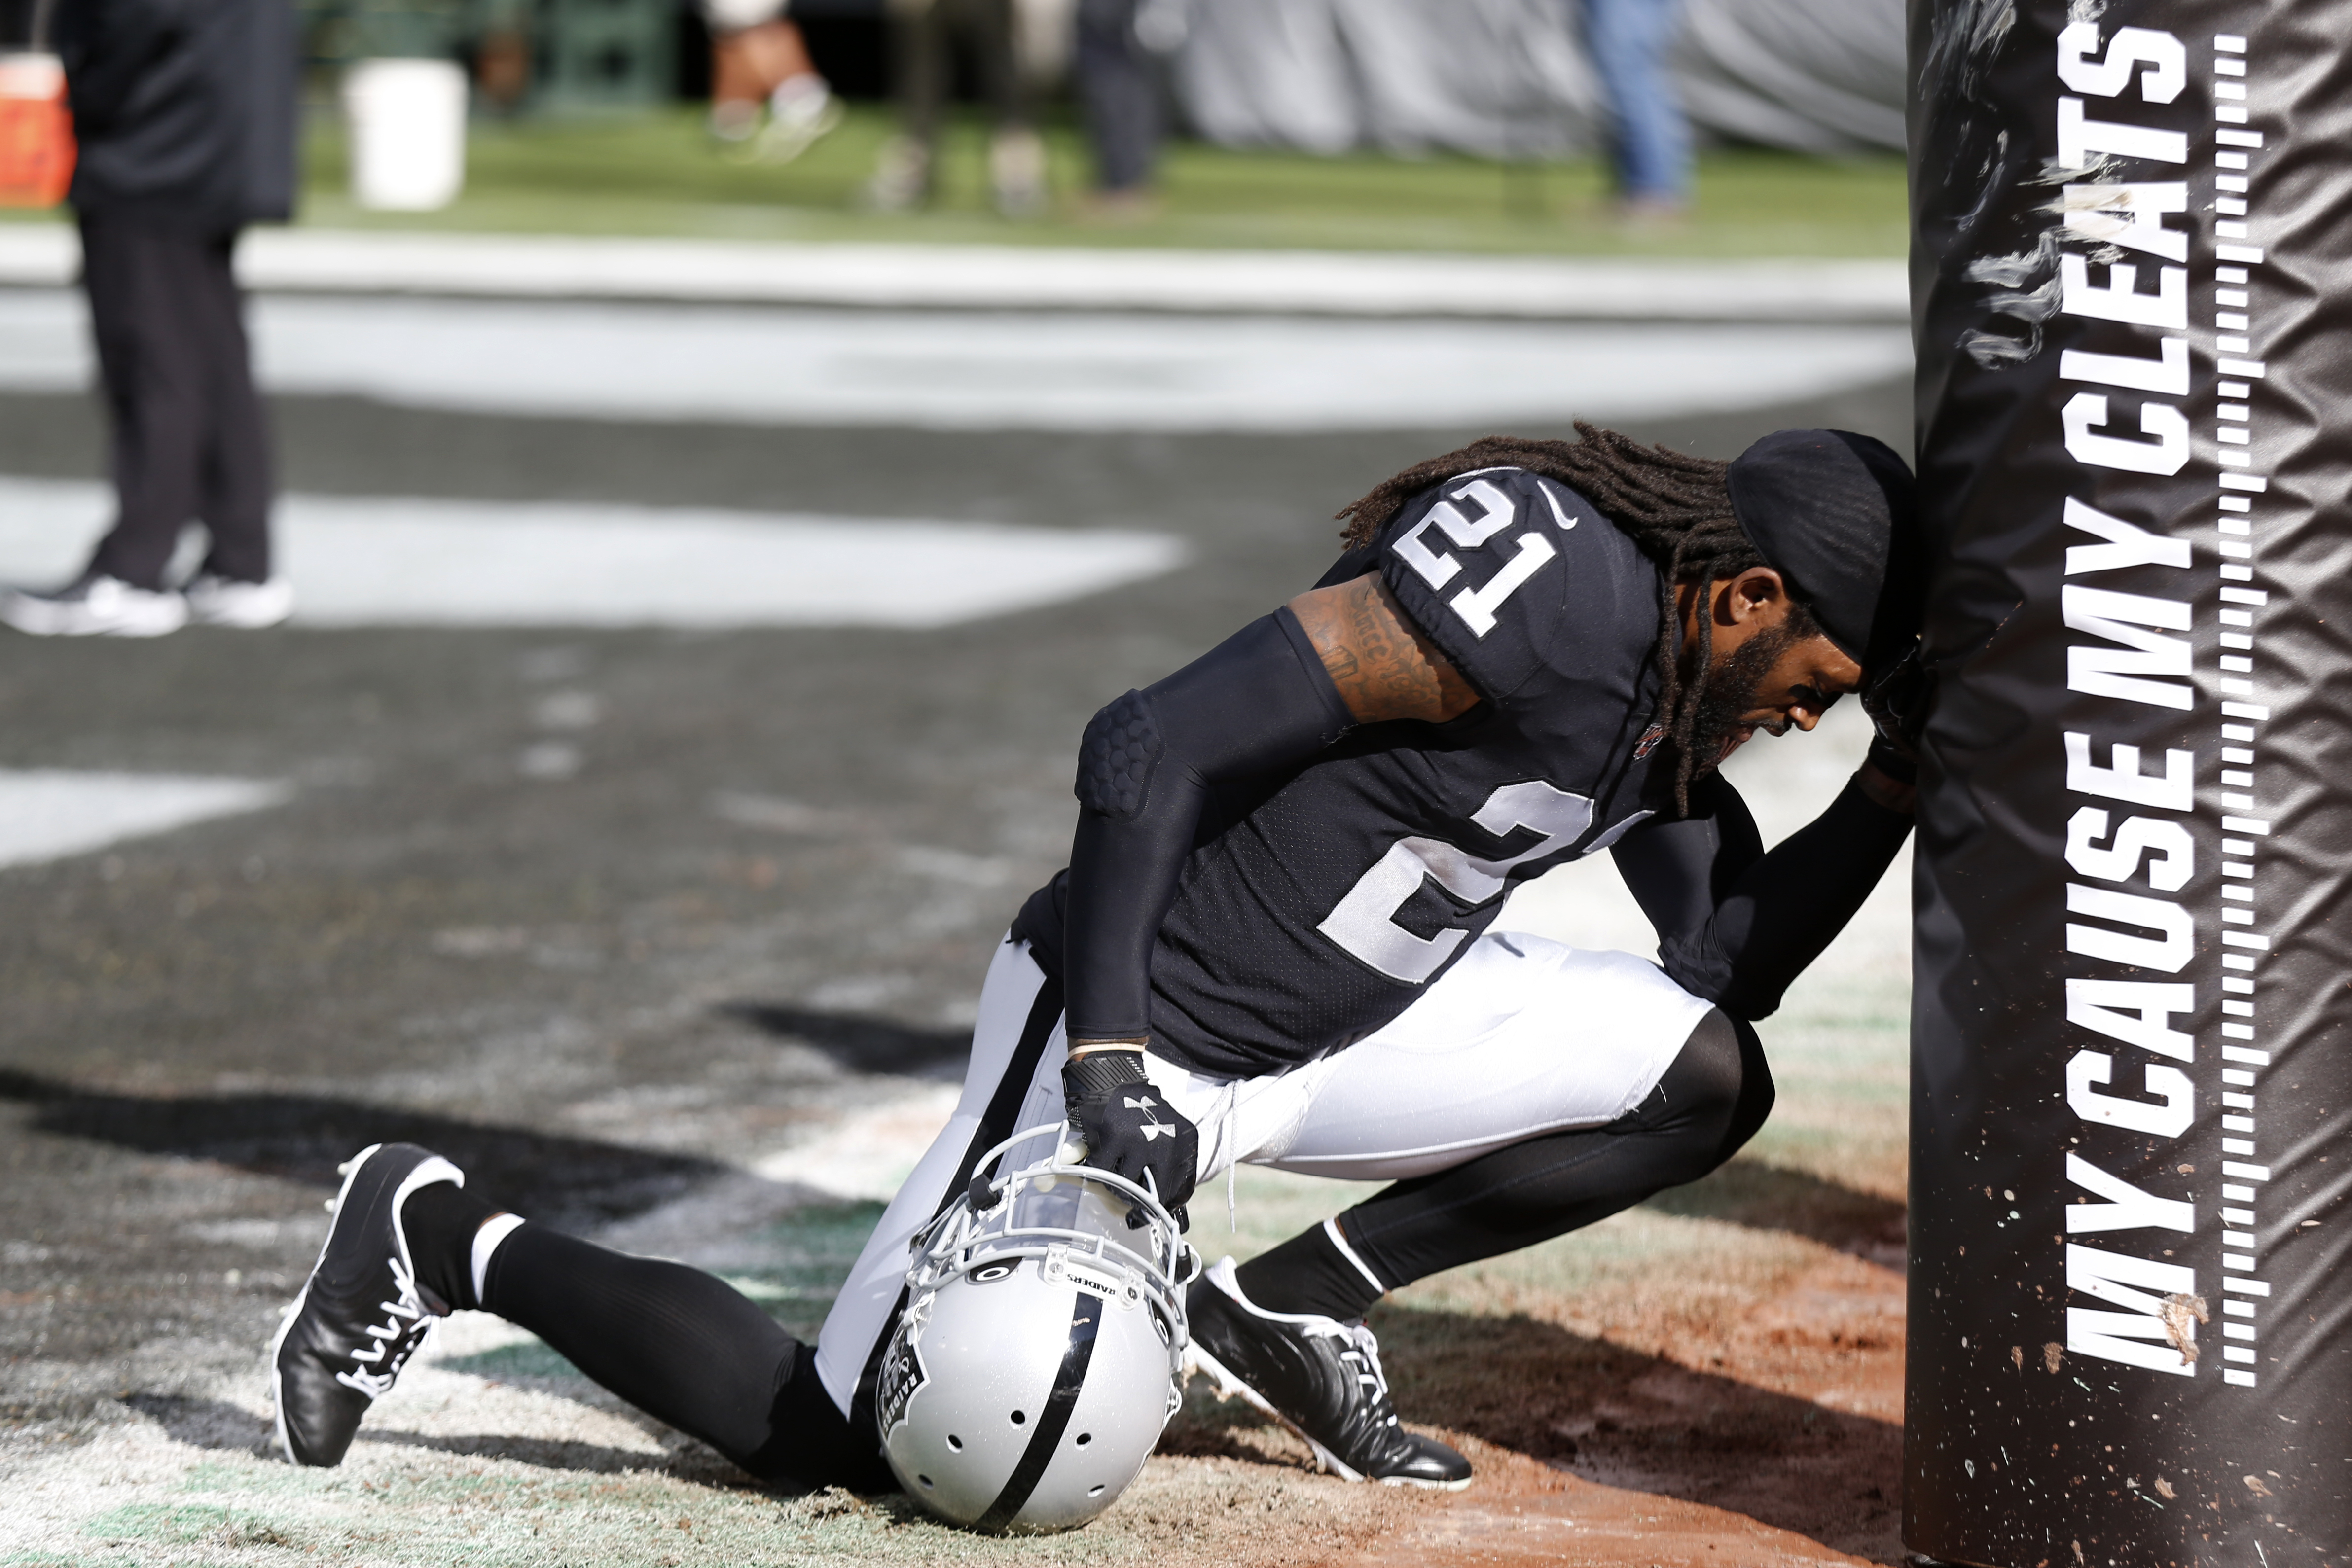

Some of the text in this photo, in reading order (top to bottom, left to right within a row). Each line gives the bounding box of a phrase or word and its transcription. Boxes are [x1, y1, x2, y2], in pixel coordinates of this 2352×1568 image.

[1391, 479, 1557, 639] 21
[2057, 21, 2196, 1377] MY CAUSE MY CLEATS
[1067, 1273, 1116, 1295] RAIDERS
[882, 1372, 917, 1432] RAIDERS
